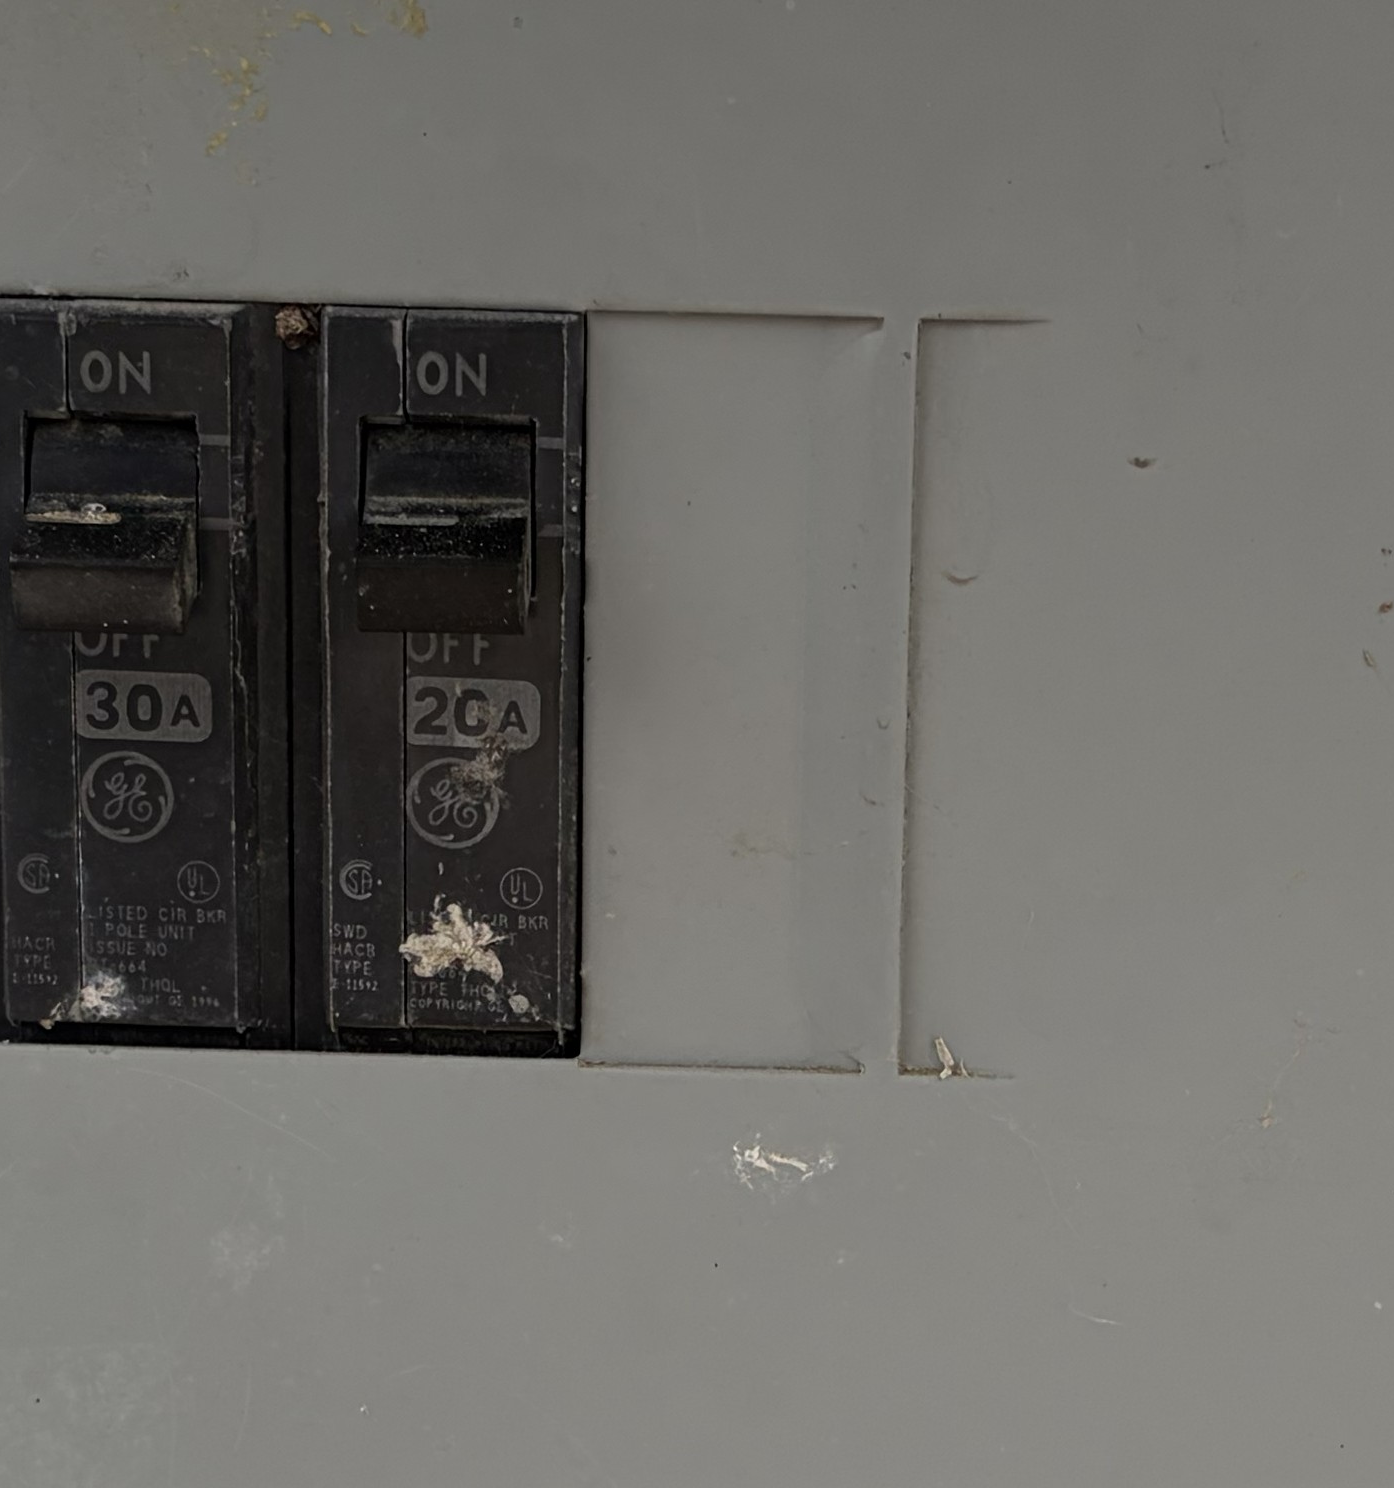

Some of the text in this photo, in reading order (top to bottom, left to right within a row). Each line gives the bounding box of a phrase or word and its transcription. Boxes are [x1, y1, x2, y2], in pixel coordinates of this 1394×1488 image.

[79, 349, 153, 396] ON
[415, 350, 487, 397] ON
[74, 631, 161, 660] OFF
[406, 632, 493, 665] OFF
[84, 679, 202, 731] 30A
[412, 687, 528, 740] 20A
[158, 907, 187, 923] CIR
[196, 908, 227, 924] BKR
[518, 914, 550, 930] BKR
[105, 923, 148, 939] POLE
[158, 925, 196, 940] UNIT
[333, 923, 368, 941] SWD
[11, 936, 56, 952] HACR
[332, 941, 376, 958] HACR
[14, 954, 52, 970] TYPE
[333, 959, 374, 977] TYPE
[410, 981, 447, 997] TYPE
